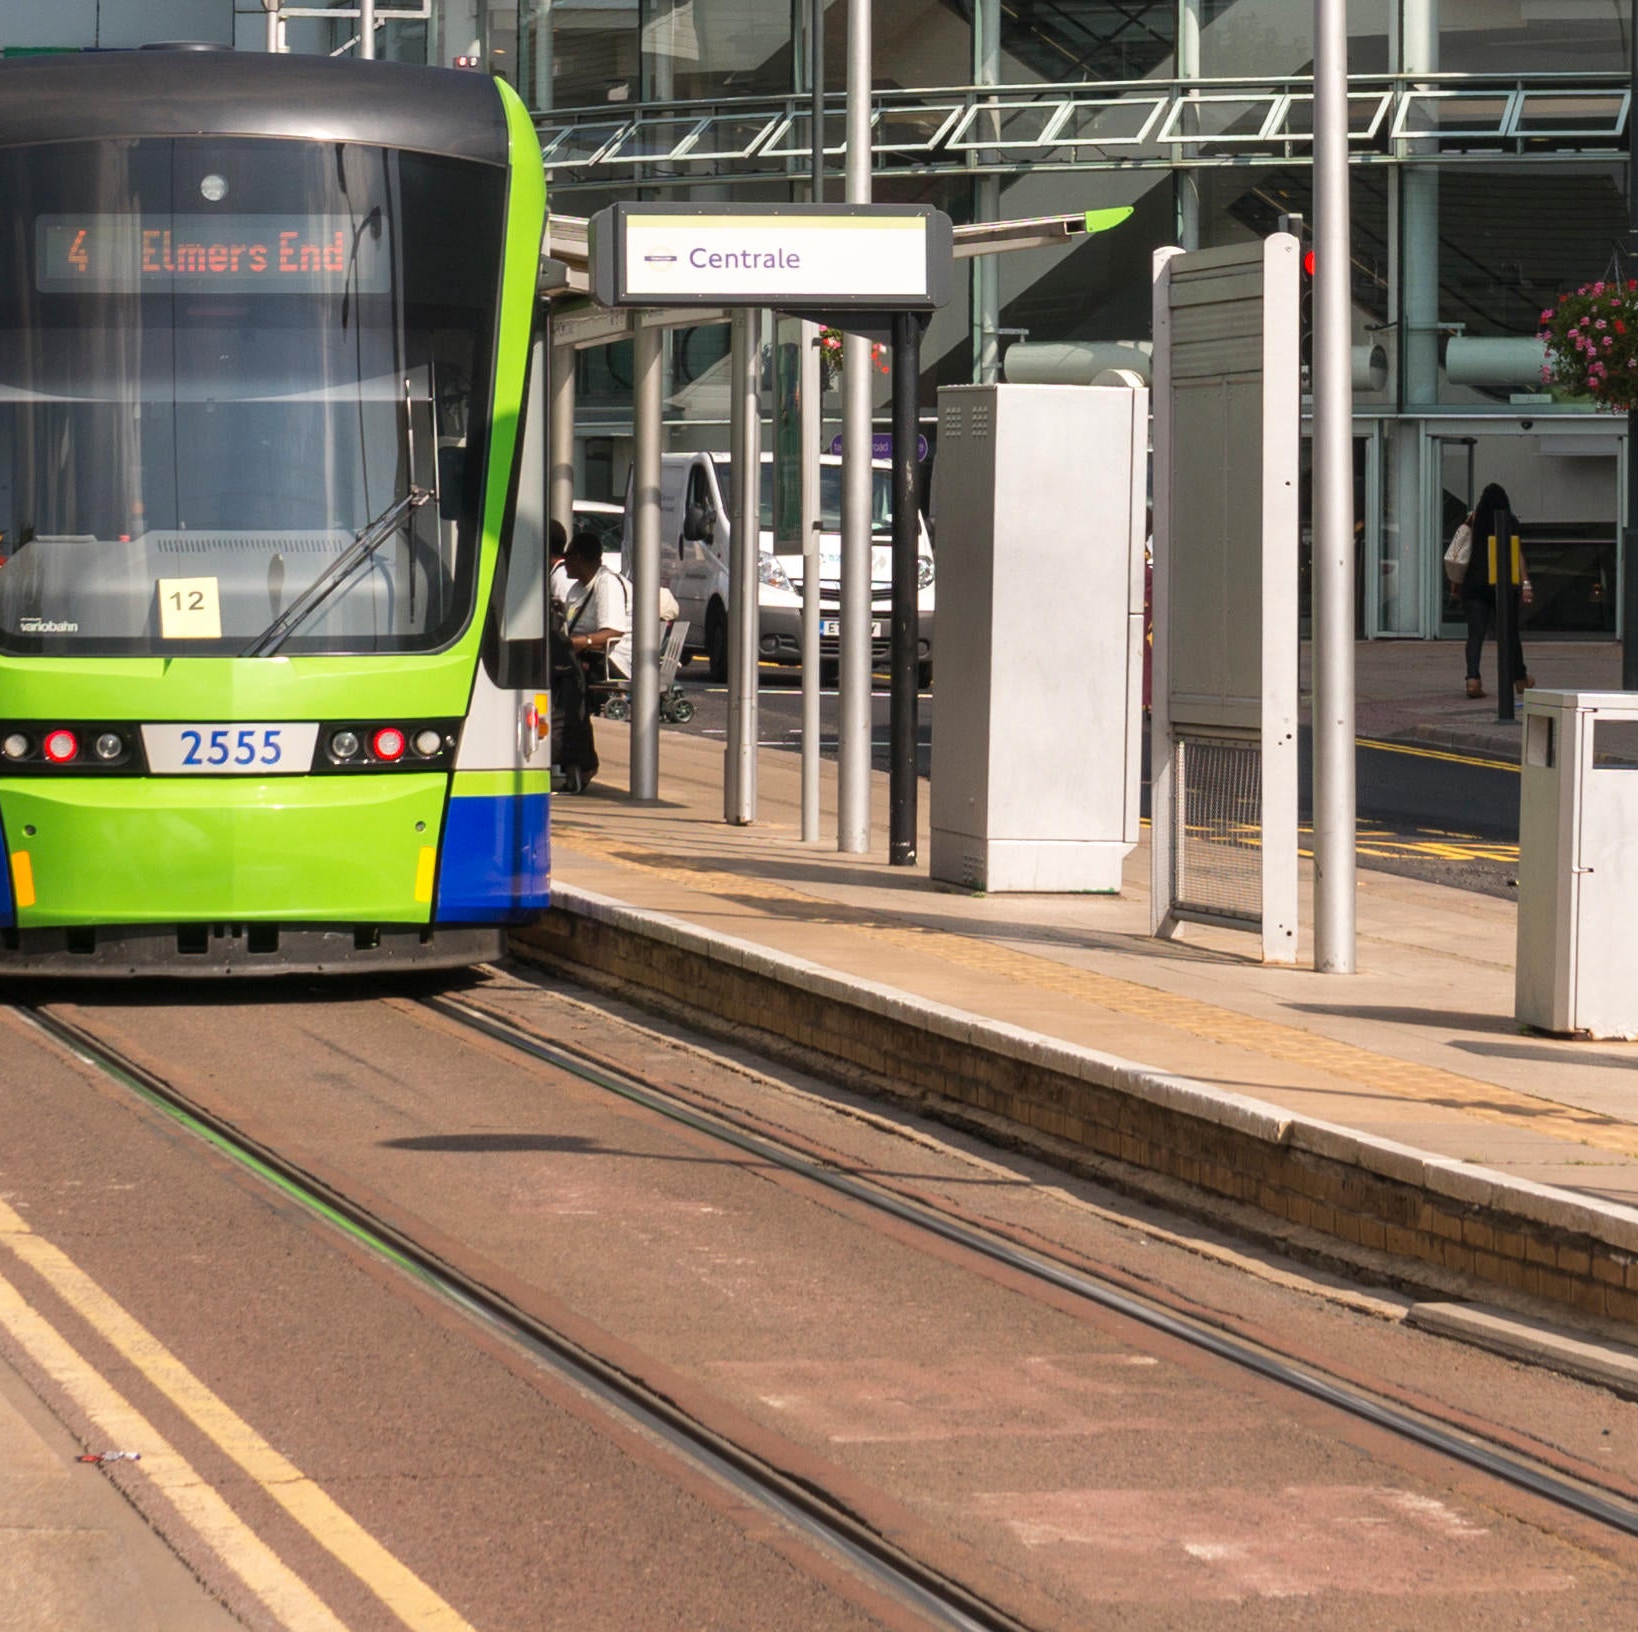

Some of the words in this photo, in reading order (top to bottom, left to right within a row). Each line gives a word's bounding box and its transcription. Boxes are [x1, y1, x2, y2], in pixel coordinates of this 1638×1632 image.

[67, 229, 88, 272] 4
[142, 229, 268, 272] Elmers
[279, 230, 344, 272] End
[689, 248, 800, 269] Centrale
[169, 591, 204, 611] 12
[20, 620, 79, 633] variobahn
[181, 730, 282, 765] 2555
